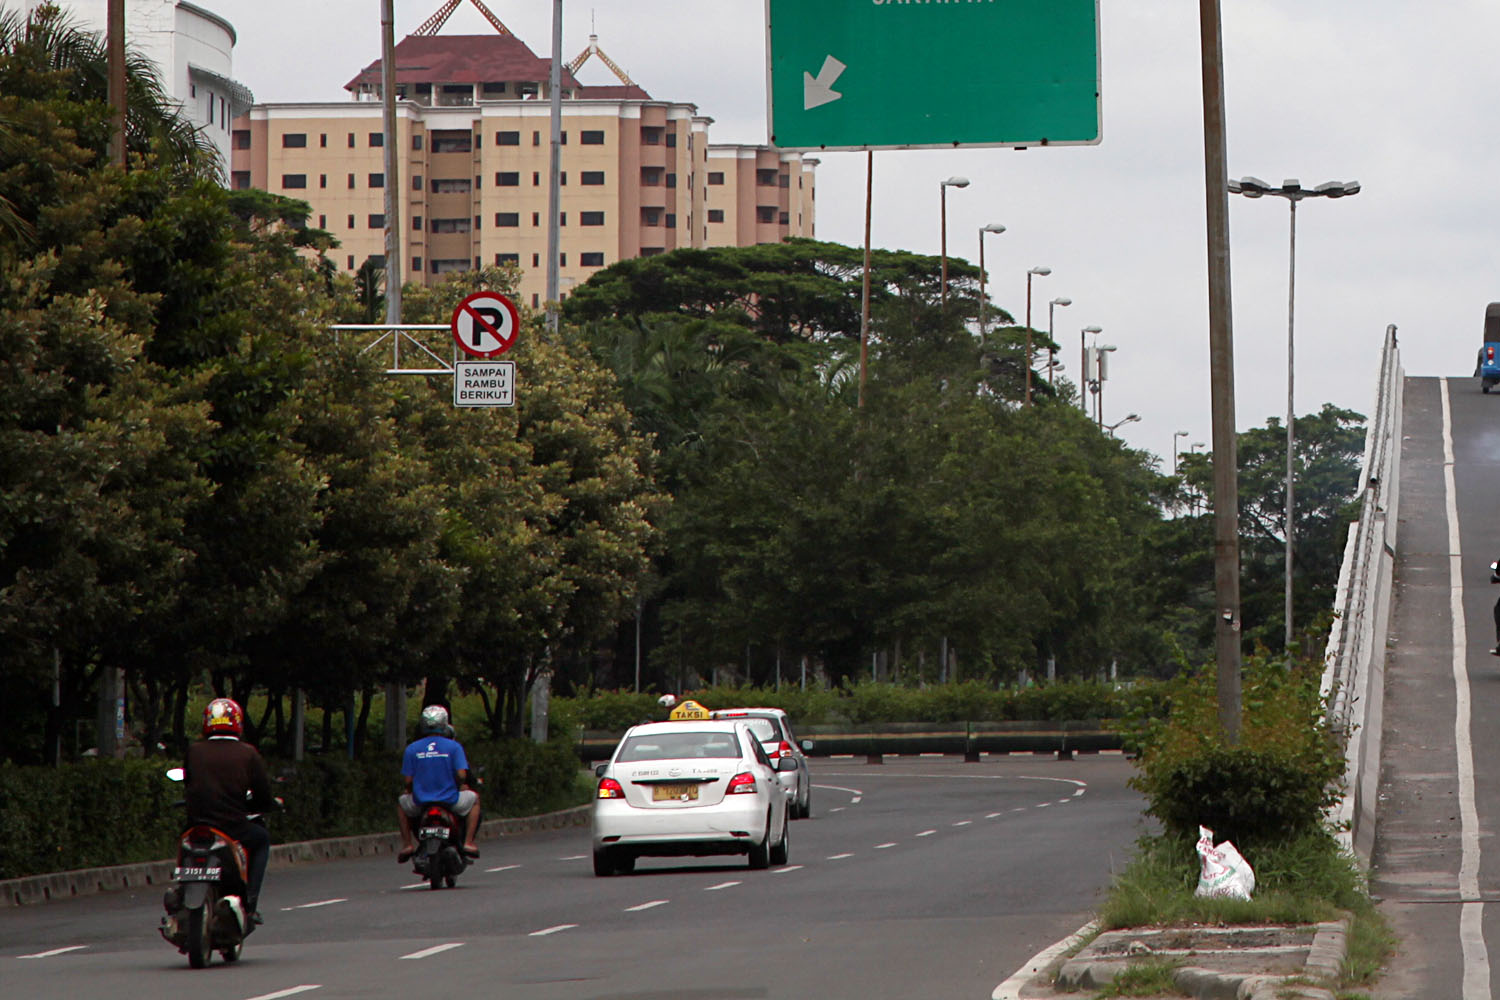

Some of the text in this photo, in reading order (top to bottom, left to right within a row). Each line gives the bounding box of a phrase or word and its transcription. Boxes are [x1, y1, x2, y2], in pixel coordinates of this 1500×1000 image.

[464, 368, 506, 377] SAMPAI
[464, 380, 505, 388] RAMBU
[460, 390, 508, 399] BERIKUT
[676, 711, 703, 719] TAKSI
